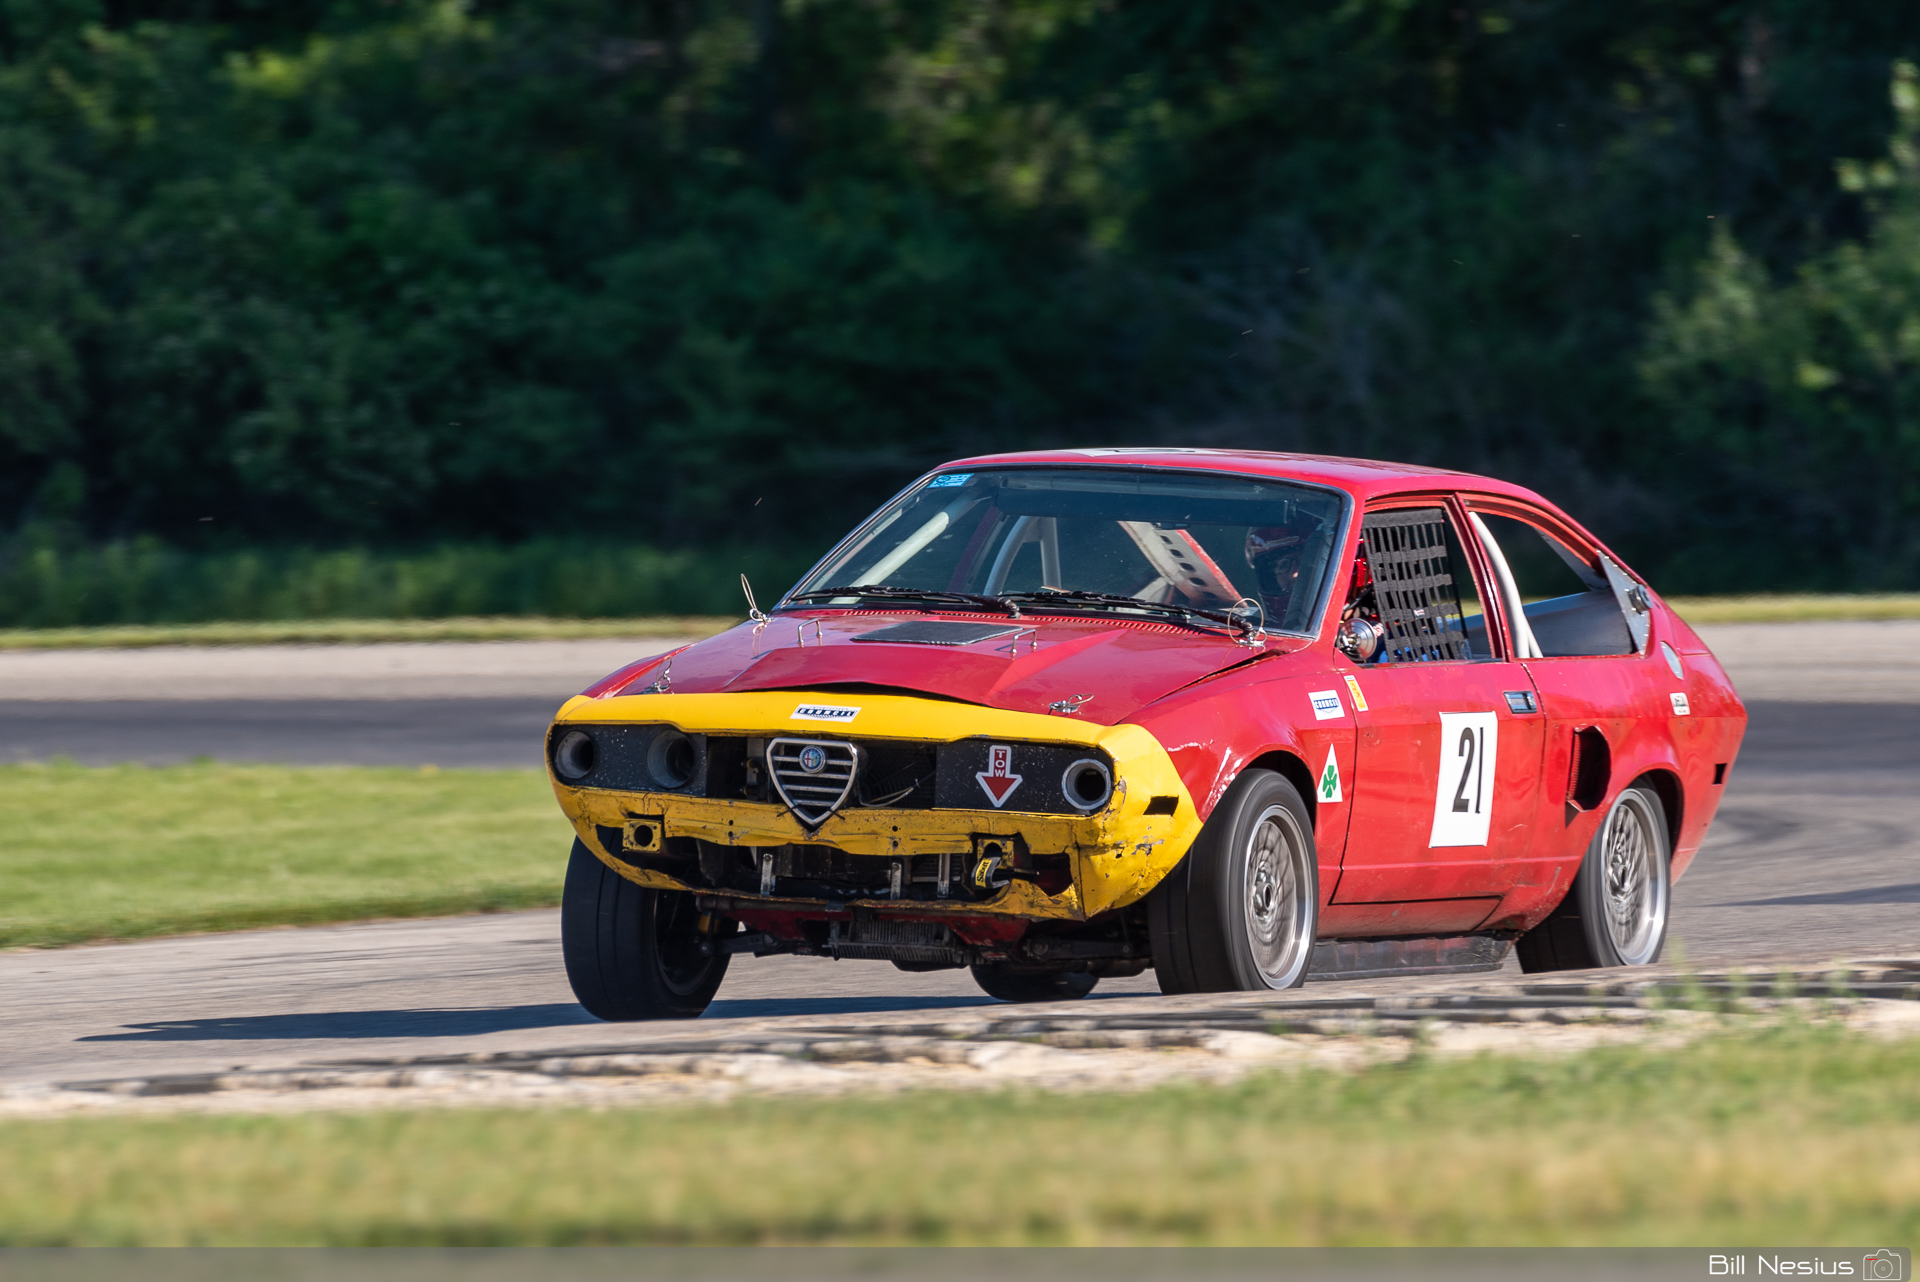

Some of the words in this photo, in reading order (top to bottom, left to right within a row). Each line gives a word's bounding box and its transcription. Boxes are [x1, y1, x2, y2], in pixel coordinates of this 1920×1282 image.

[798, 708, 853, 717] COUNCIL
[994, 750, 1006, 778] TOW
[1452, 727, 1484, 814] 21
